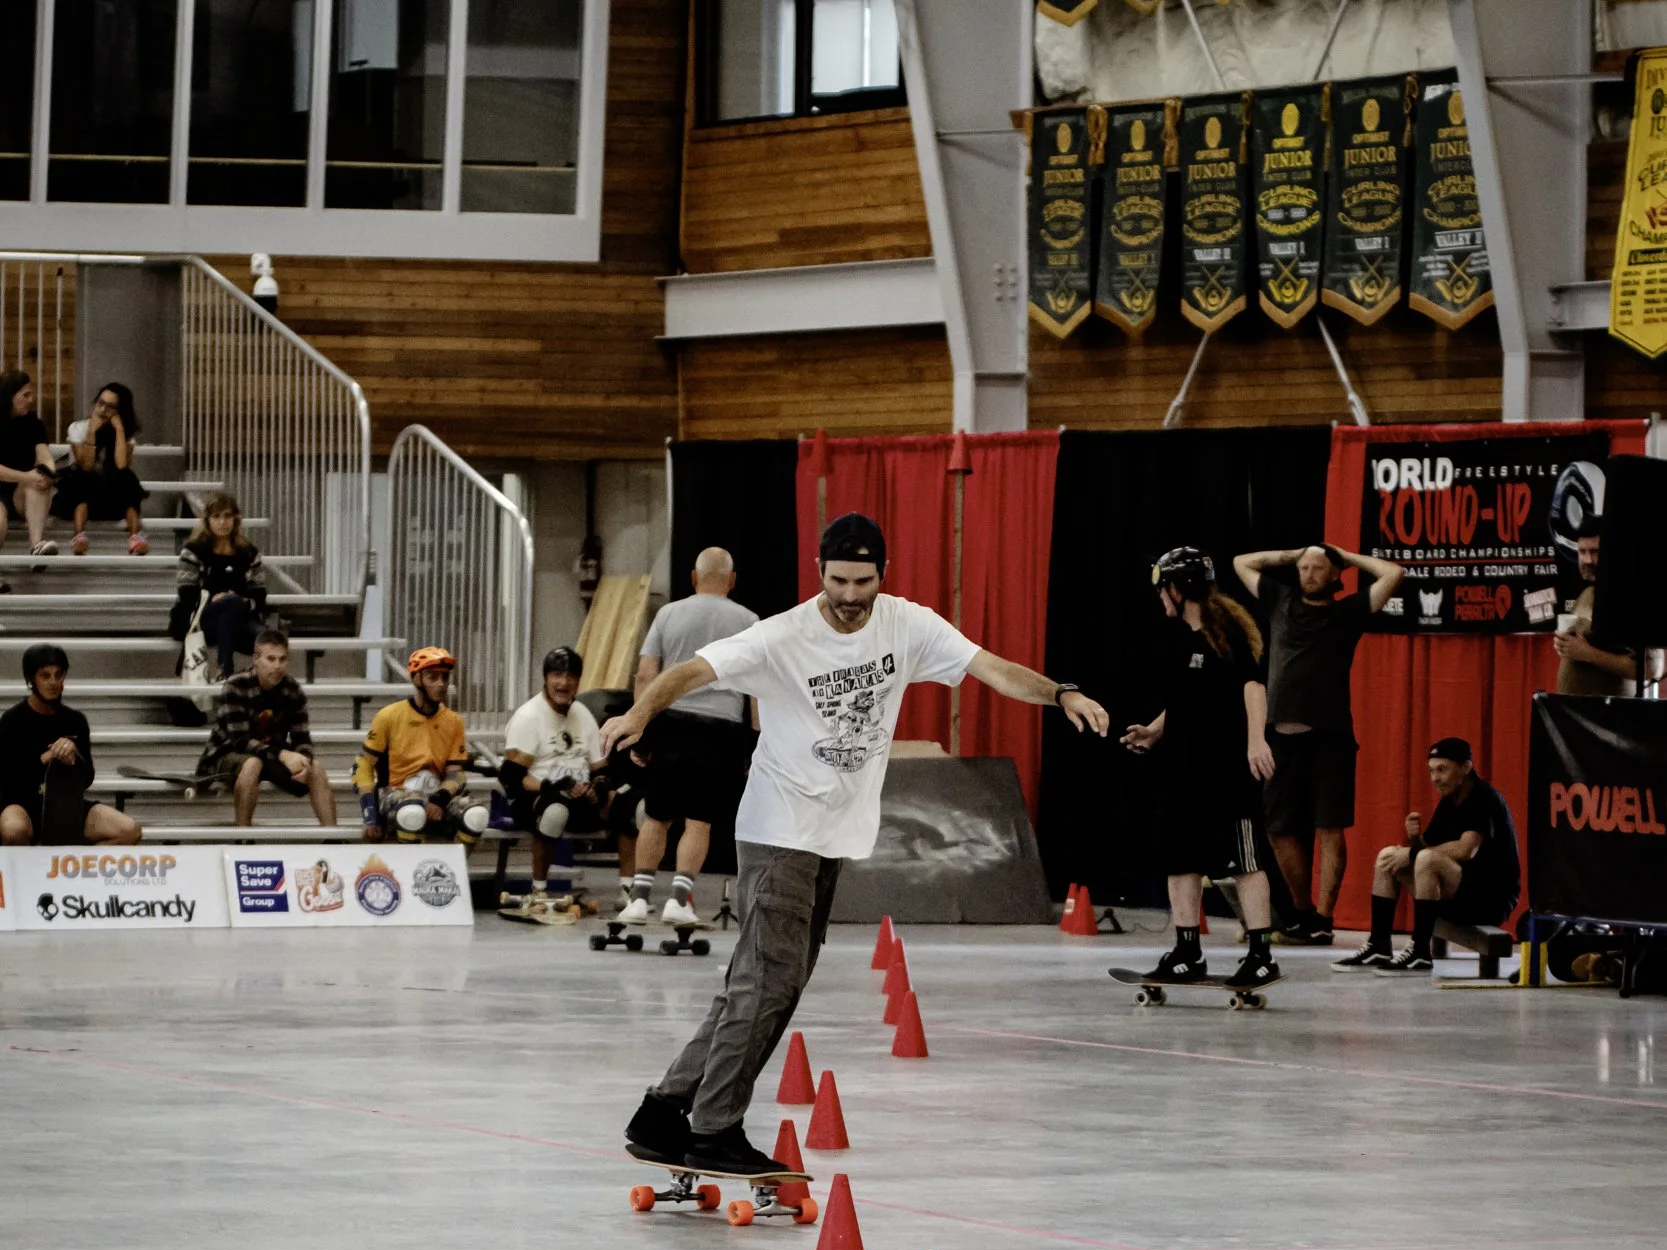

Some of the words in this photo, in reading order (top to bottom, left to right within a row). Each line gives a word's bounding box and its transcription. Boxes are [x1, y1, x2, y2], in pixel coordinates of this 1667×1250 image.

[1264, 150, 1312, 173] JUNIOR
[1344, 146, 1397, 169] JUNIOR
[1430, 140, 1471, 162] JUNIO
[1188, 162, 1237, 184] JUNIOR
[1259, 184, 1318, 204] CURLING
[1424, 208, 1481, 229] CHAMPION
[1454, 464, 1558, 479] FREESTYLE
[1379, 483, 1532, 545] ROUND-UP
[1450, 546, 1556, 559] CHAMPIONSHIPS
[1434, 566, 1466, 577] RODEO
[1484, 564, 1529, 577] COUNTRY
[1535, 564, 1558, 575] FAIR
[1455, 585, 1495, 602] POWELL
[808, 673, 831, 687] THE
[826, 669, 885, 699] KANAKAS
[1551, 782, 1666, 835] POWELL
[46, 854, 177, 879] JOECORP
[239, 864, 279, 877] Super
[241, 875, 272, 887] Save
[62, 894, 196, 923] Skullcandy
[242, 897, 275, 907] Group
